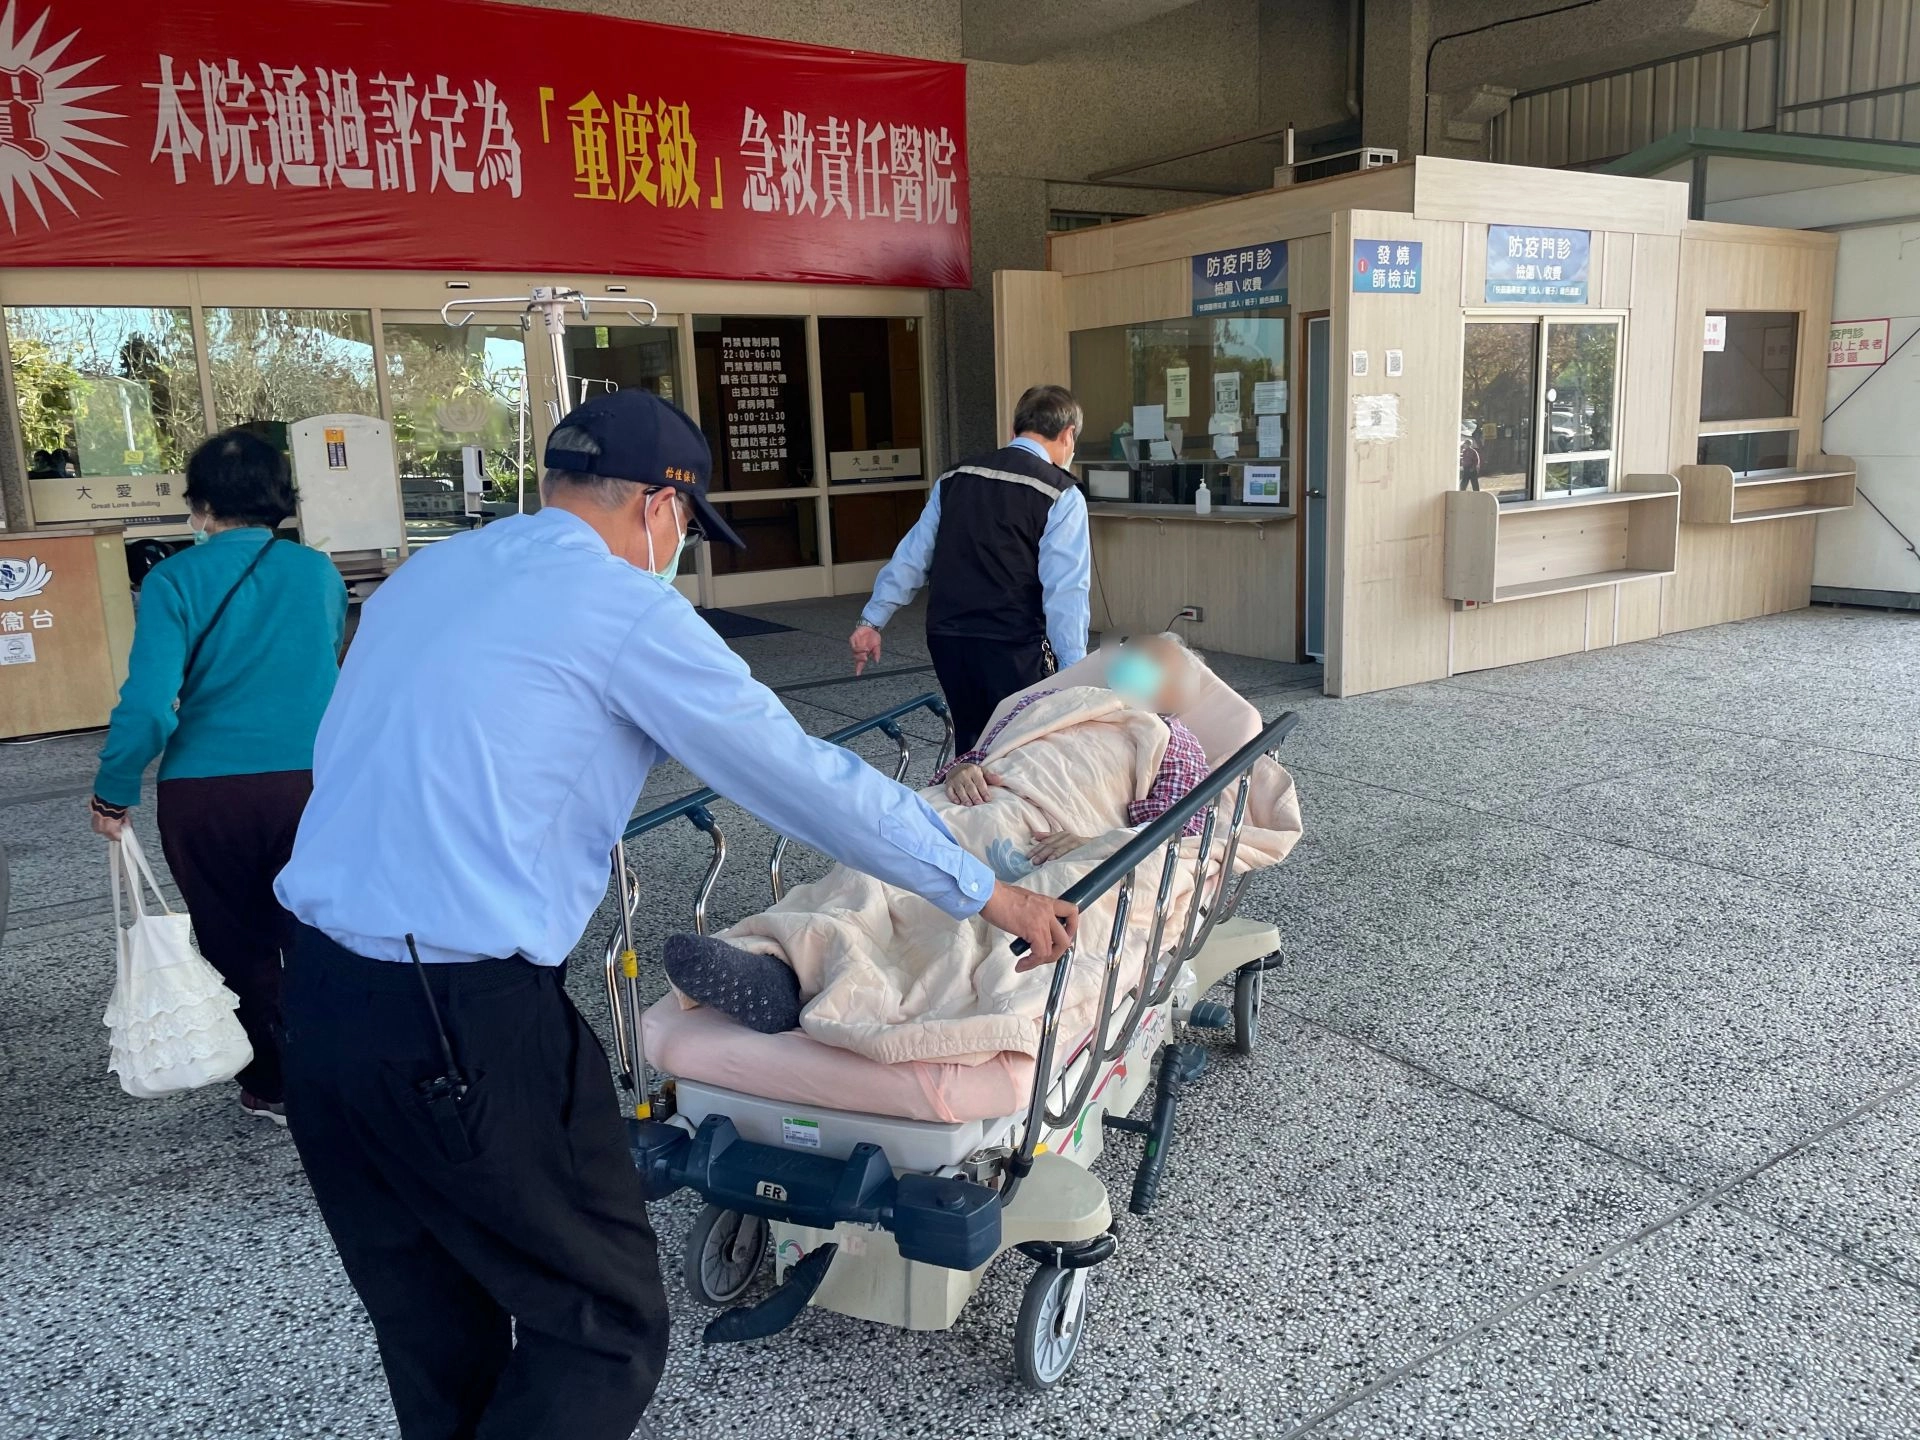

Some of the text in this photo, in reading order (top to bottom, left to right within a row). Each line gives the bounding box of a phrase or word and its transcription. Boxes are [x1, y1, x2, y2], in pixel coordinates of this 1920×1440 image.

[1376, 245, 1411, 266] 發燒
[1508, 235, 1571, 260] 防疫門診
[1206, 247, 1272, 278] 防疫門診
[1372, 268, 1417, 289] 篩檢站
[723, 349, 781, 359] 22:00-06:00
[728, 411, 785, 422] 09:00-21:30
[76, 482, 171, 500] 大愛樓
[763, 1184, 782, 1199] ER
